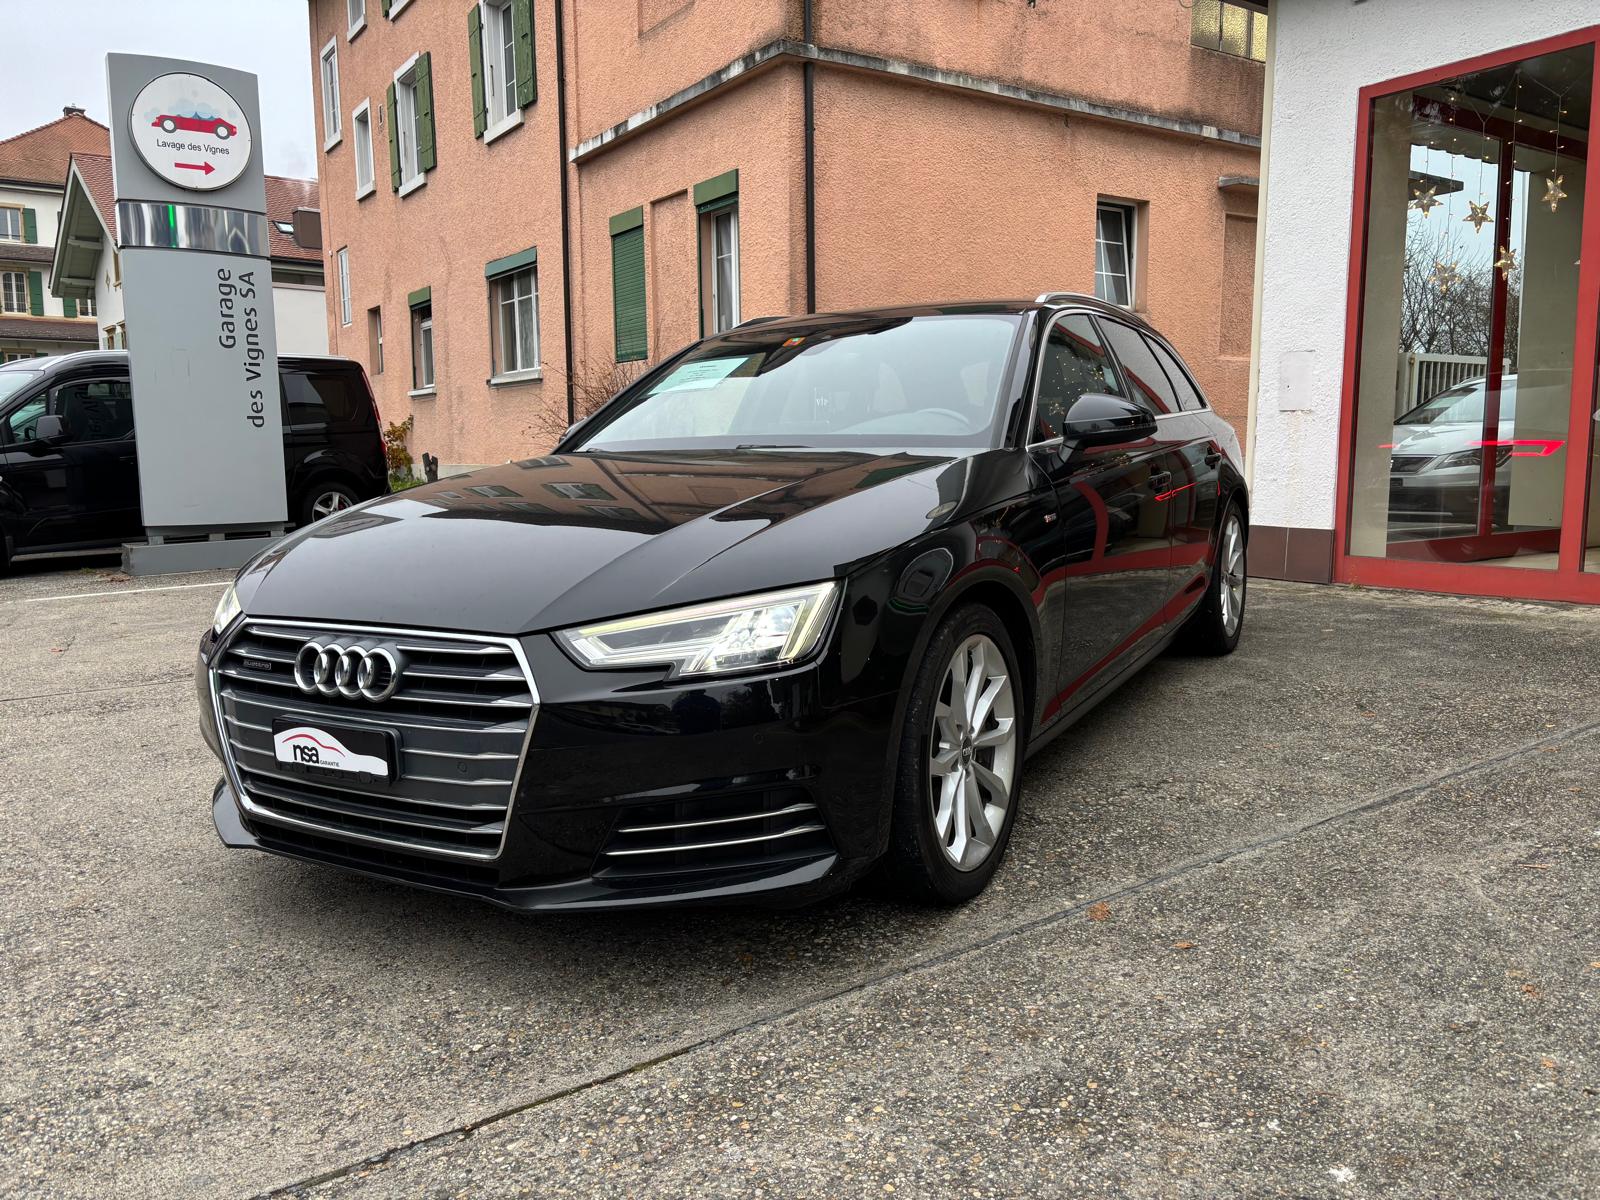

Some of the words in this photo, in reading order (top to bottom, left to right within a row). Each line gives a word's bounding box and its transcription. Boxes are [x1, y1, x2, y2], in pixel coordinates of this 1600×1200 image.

[156, 138, 186, 151] Lavage
[187, 142, 202, 152] des
[203, 144, 230, 155] Vignes
[238, 271, 256, 299] SA
[217, 268, 237, 349] Garage
[243, 307, 264, 382] Vignes
[246, 390, 265, 428] des
[293, 744, 320, 764] nsa
